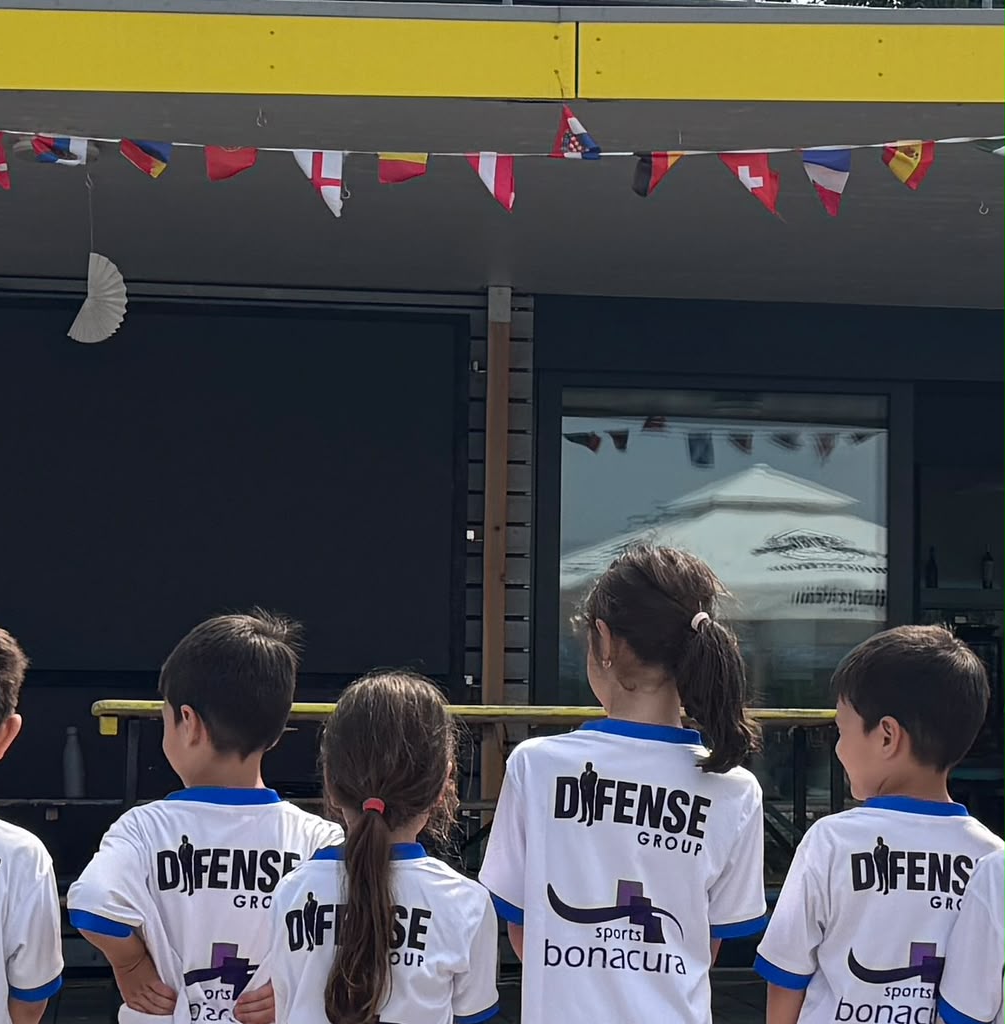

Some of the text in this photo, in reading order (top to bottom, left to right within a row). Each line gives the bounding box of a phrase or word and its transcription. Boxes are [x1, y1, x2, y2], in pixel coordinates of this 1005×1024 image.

[637, 831, 703, 857] GROUP
[233, 894, 273, 909] GRO
[595, 926, 642, 942] sports
[390, 952, 424, 967] OUP
[544, 939, 687, 975] bonacura
[204, 989, 232, 1000] orts
[884, 986, 932, 1000] sports
